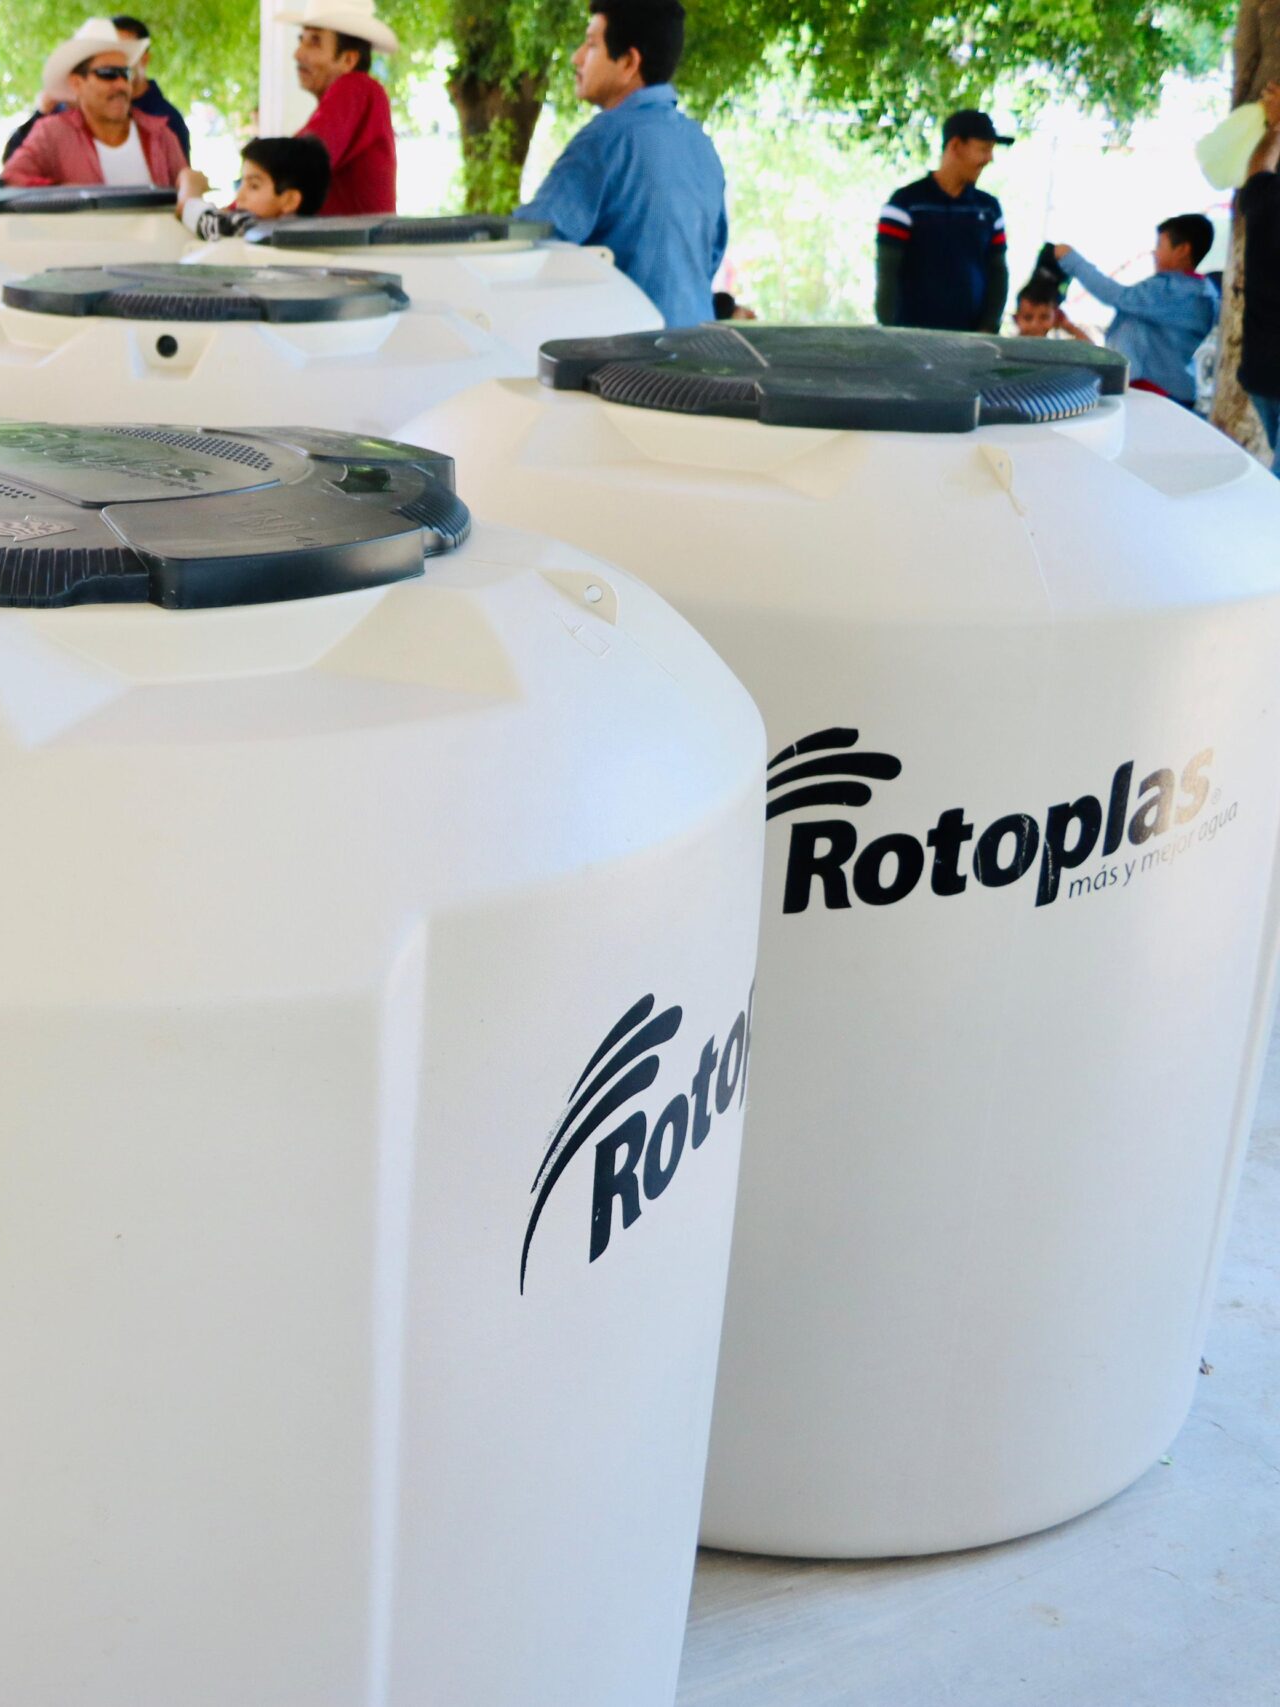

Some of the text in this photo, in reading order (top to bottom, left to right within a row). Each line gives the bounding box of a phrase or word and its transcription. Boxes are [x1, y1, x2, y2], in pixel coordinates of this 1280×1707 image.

[782, 747, 1214, 914] Rotoplas
[1069, 801, 1239, 898] más y mejor agua
[589, 980, 754, 1264] Roto
